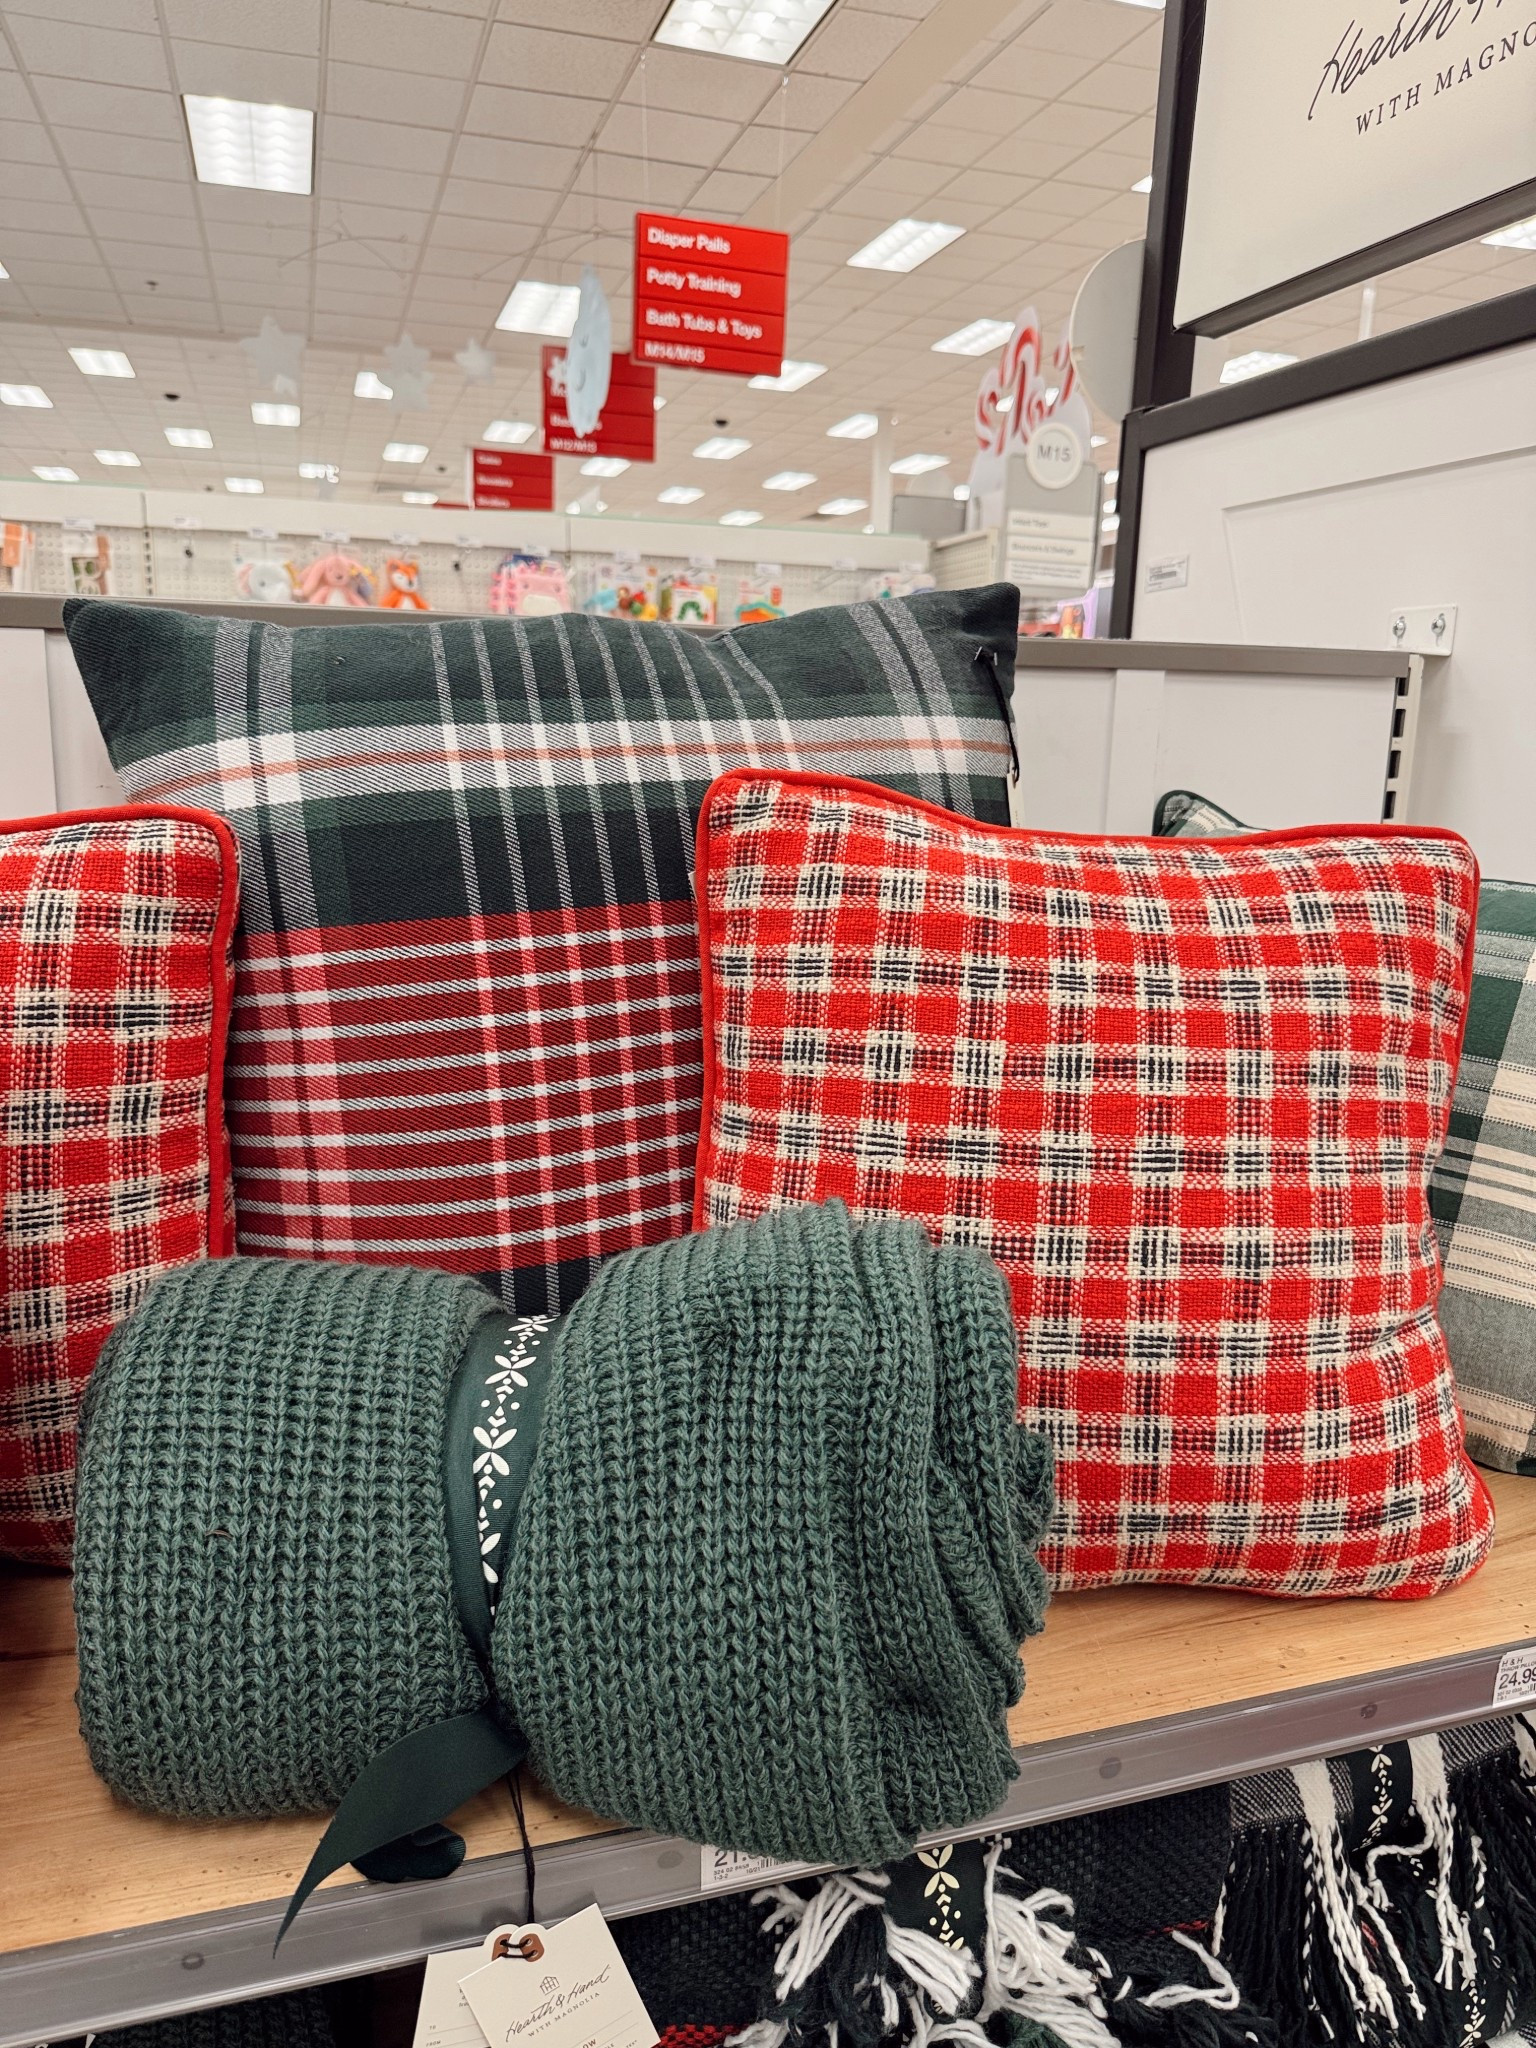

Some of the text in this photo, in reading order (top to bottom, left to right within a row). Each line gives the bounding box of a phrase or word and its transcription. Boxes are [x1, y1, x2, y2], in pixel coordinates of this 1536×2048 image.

[1355, 82, 1422, 135] WITH
[647, 226, 731, 254] Diaper Pails
[646, 266, 742, 298] Potty Training
[645, 307, 763, 341] Bath Tubs & Toys
[644, 340, 706, 364] M14/M15
[1036, 443, 1071, 463] M15
[505, 1995, 555, 2043] Hearth
[555, 1993, 566, 2009] &
[566, 1964, 610, 2004] Hand
[528, 1992, 600, 2038] WITH MAGNOLIA
